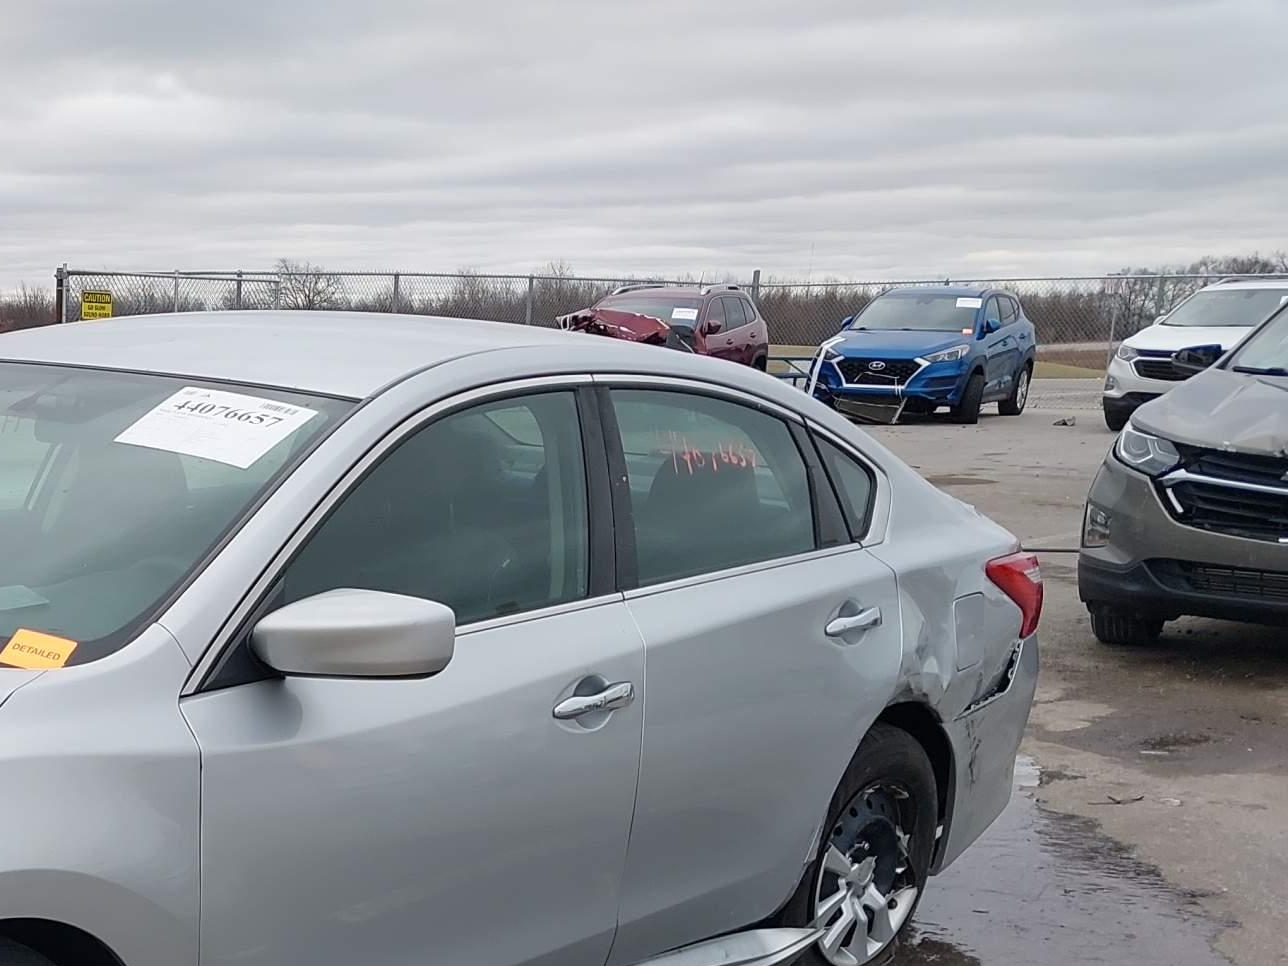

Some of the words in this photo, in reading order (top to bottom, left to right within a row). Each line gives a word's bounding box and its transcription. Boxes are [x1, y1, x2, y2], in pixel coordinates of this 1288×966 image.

[84, 293, 111, 303] CAUTION
[173, 399, 284, 428] 44076657
[12, 642, 61, 661] DETAILED
